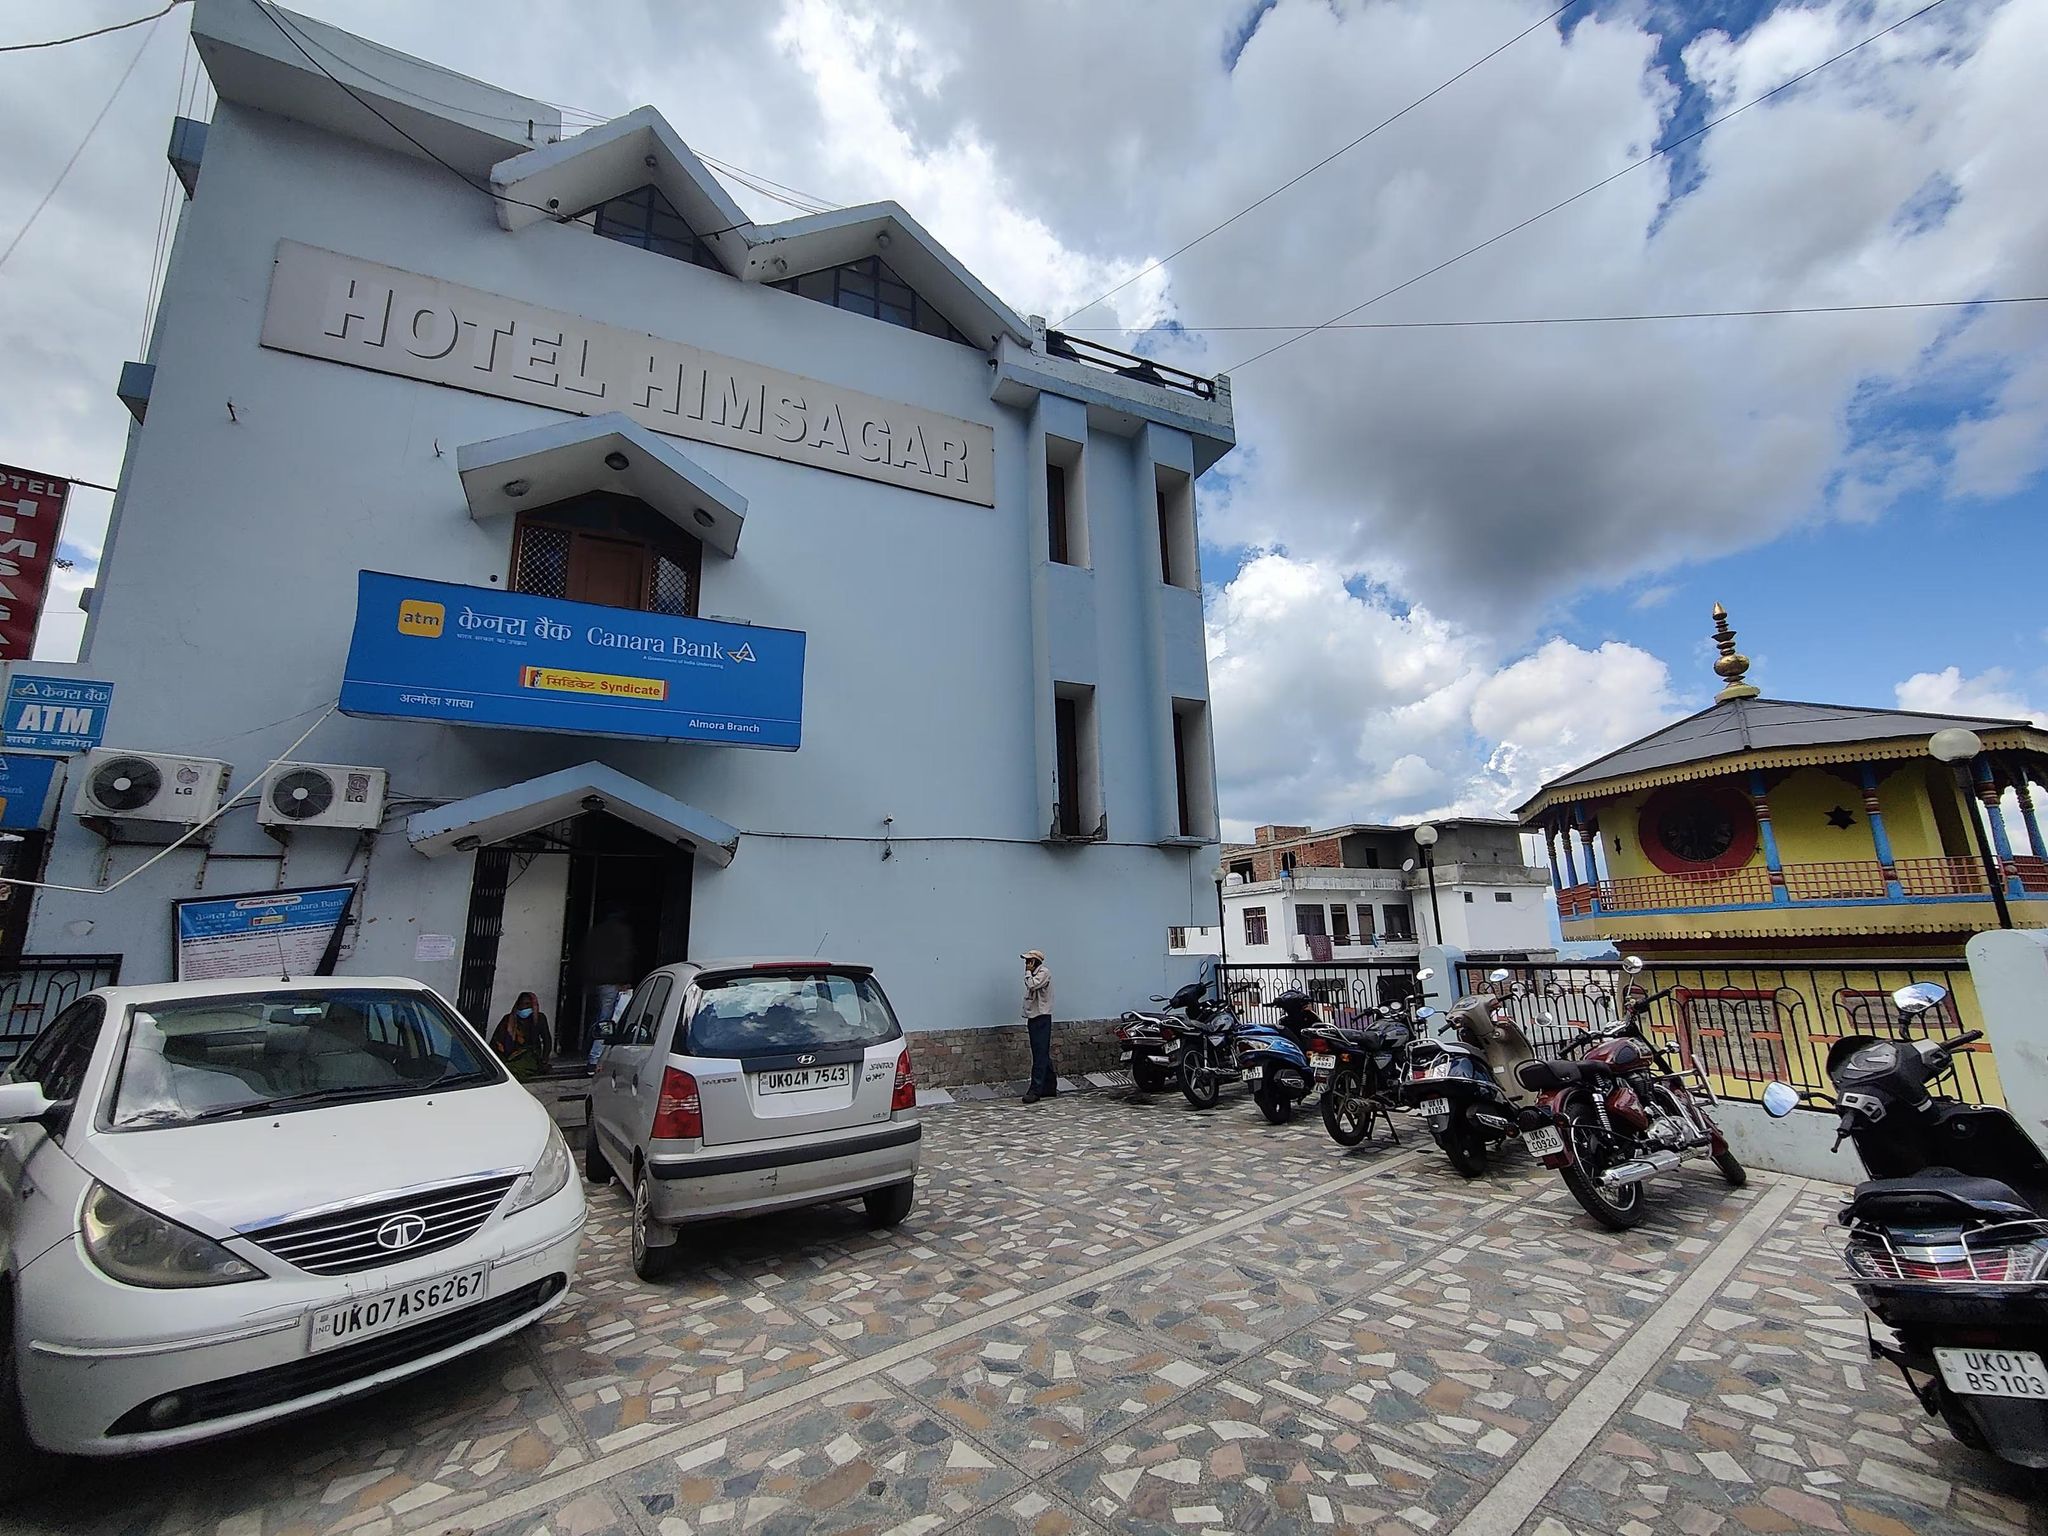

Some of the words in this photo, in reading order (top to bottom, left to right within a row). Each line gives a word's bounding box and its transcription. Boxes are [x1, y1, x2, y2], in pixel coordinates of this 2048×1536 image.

[324, 276, 606, 398] HOTEL
[633, 353, 969, 484] HIMSAGAR
[0, 474, 62, 498] OTEL
[403, 611, 440, 627] atm
[458, 606, 528, 637] केनरा
[534, 616, 572, 641] बैंक
[587, 626, 665, 653] Canara
[673, 637, 724, 660] Bank
[42, 684, 81, 701] केनरा
[85, 687, 108, 702] बैंक
[600, 680, 660, 696] Syndicate
[400, 692, 441, 708] अल्मोड़ा
[445, 697, 474, 709] शाखा
[16, 704, 94, 735] ATM
[689, 719, 724, 730] Almora
[727, 721, 760, 733] Branch
[6, 735, 37, 745] शाखा
[175, 787, 193, 796] LG
[347, 795, 364, 803] LG
[285, 902, 319, 912] Canara
[321, 899, 344, 909] Bank
[814, 1067, 845, 1084] 7543
[1529, 1129, 1550, 1141] UK01
[315, 1323, 331, 1335] IND
[333, 1271, 483, 1337] UK07AS6267
[1965, 1352, 2028, 1375] UK01
[1966, 1372, 2046, 1396] B5103
